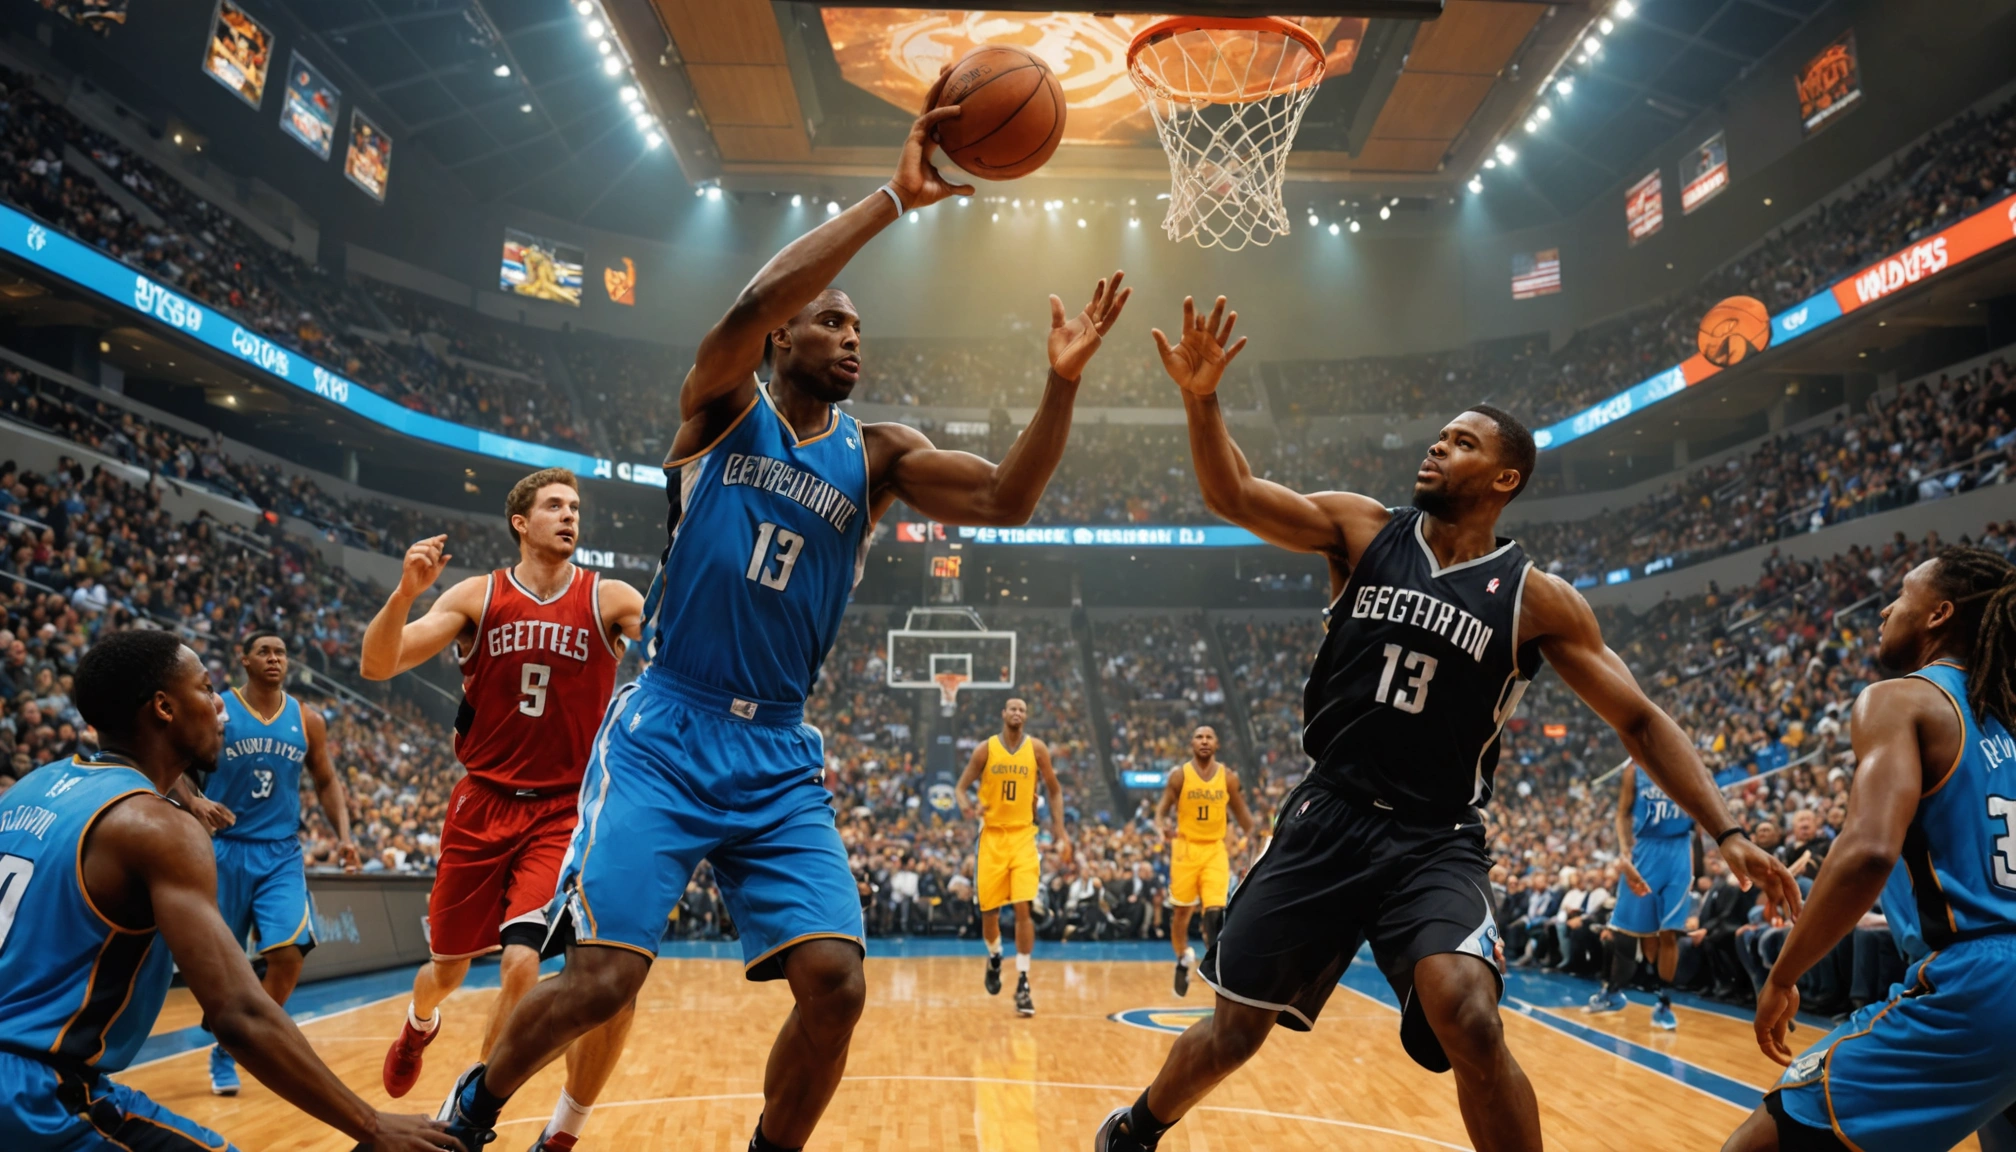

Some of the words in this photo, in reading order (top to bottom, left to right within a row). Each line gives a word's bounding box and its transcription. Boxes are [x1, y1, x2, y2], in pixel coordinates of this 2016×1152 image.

[746, 521, 805, 592] 13
[519, 662, 551, 718] 9
[1374, 643, 1439, 715] 13
